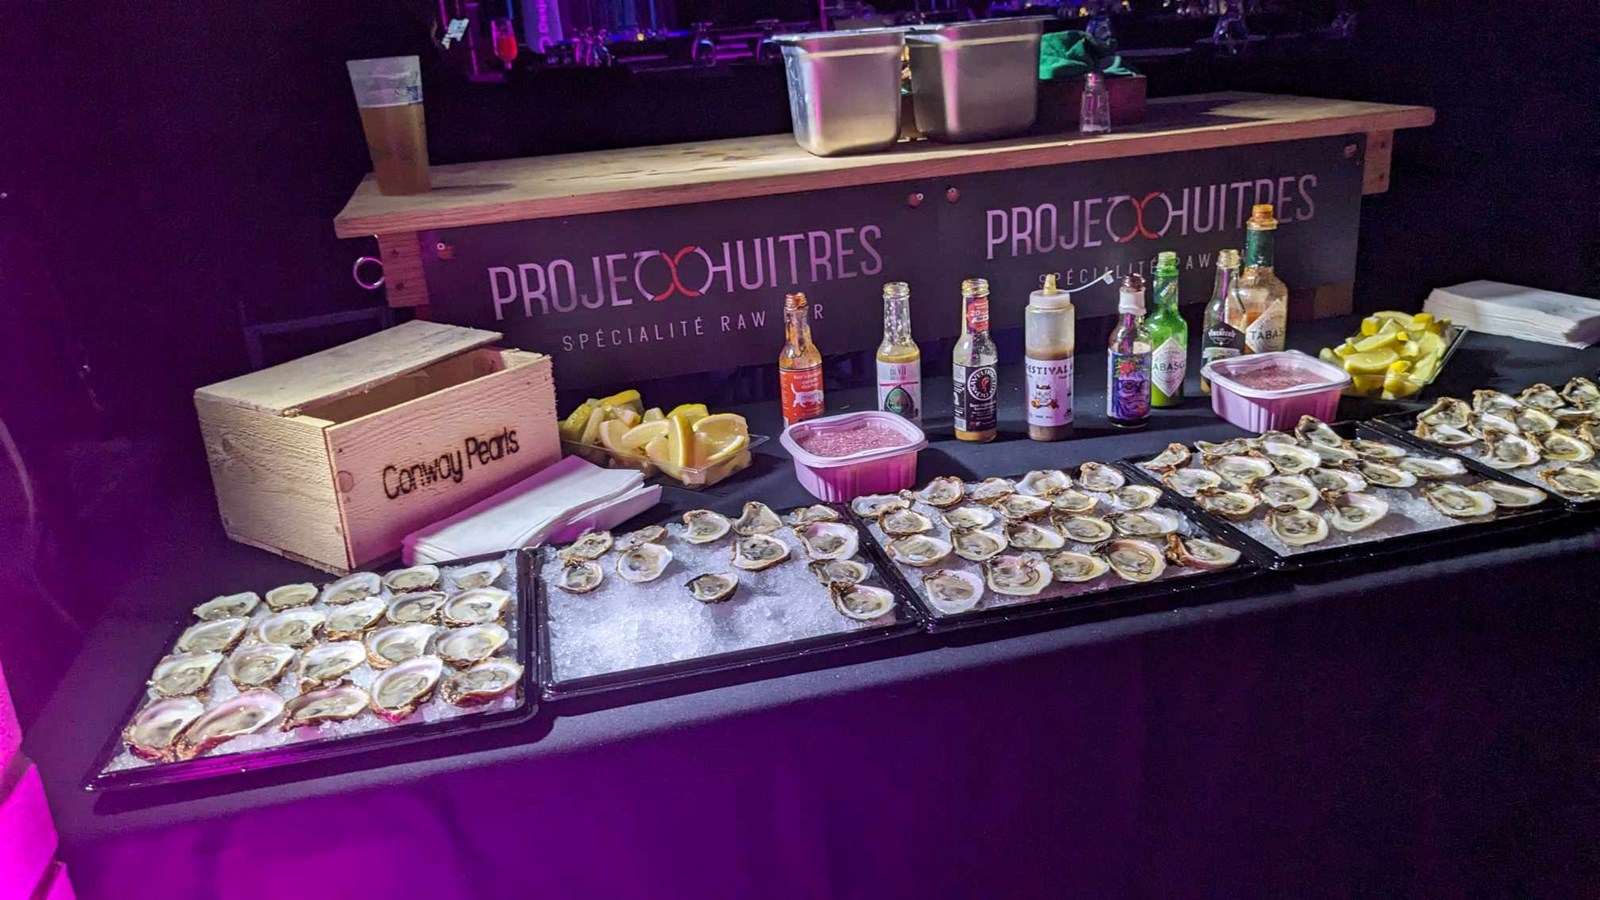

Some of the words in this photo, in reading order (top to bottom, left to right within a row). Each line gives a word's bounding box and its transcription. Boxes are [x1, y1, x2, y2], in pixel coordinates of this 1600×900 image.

[562, 317, 705, 353] SPÉCIALITÉ
[721, 310, 768, 332] RAW
[382, 449, 464, 501] Conway
[464, 426, 520, 470] Pearls
